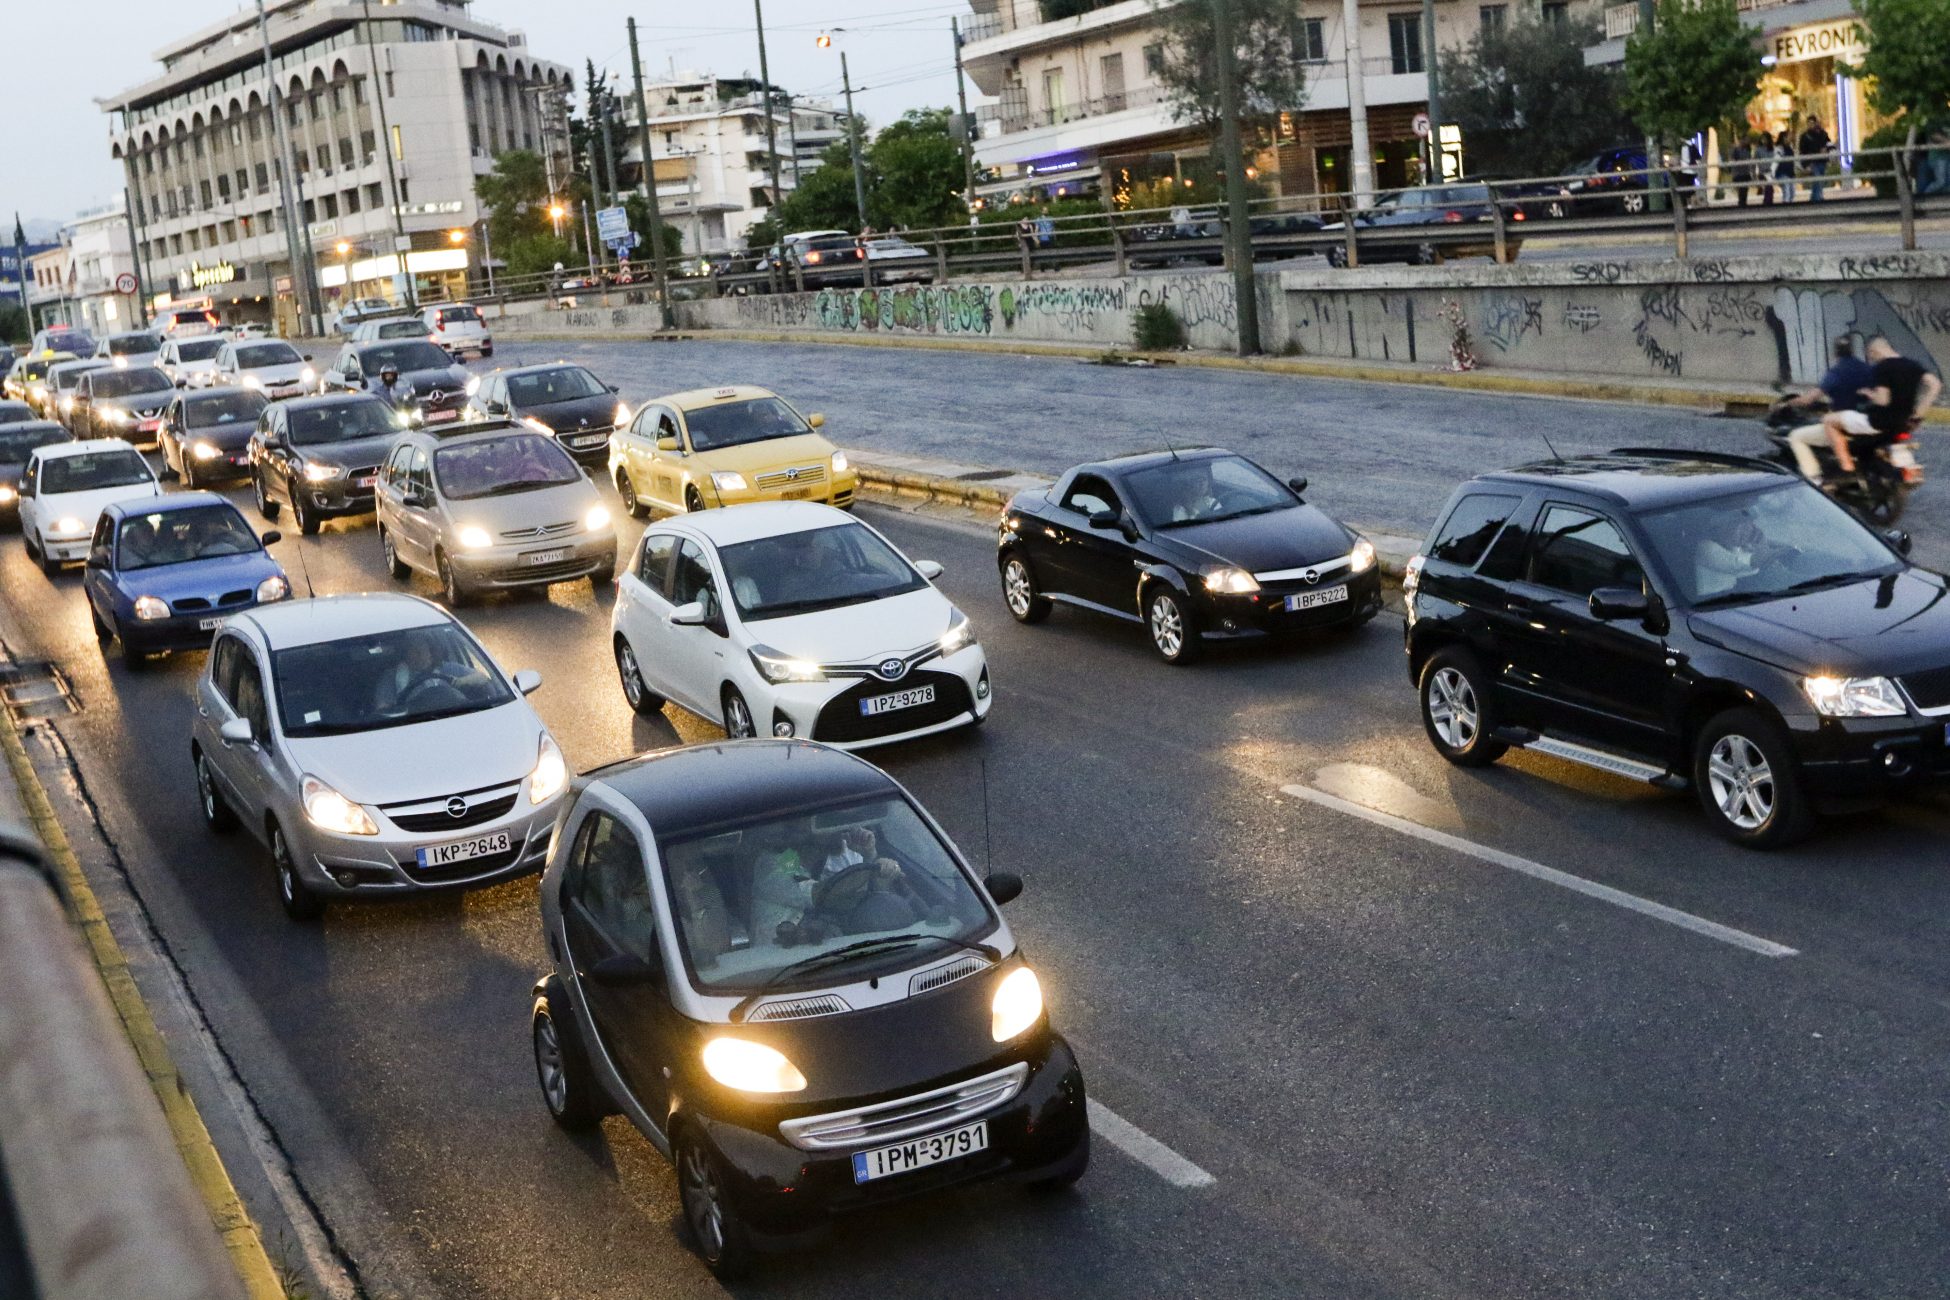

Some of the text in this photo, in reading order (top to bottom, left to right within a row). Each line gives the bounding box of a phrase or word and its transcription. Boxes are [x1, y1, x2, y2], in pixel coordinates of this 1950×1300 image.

[1297, 586, 1347, 609] IBP-6222
[873, 687, 934, 713] IPZ-9278
[433, 834, 508, 864] IKP-2648
[877, 1124, 985, 1174] IPM-3791
